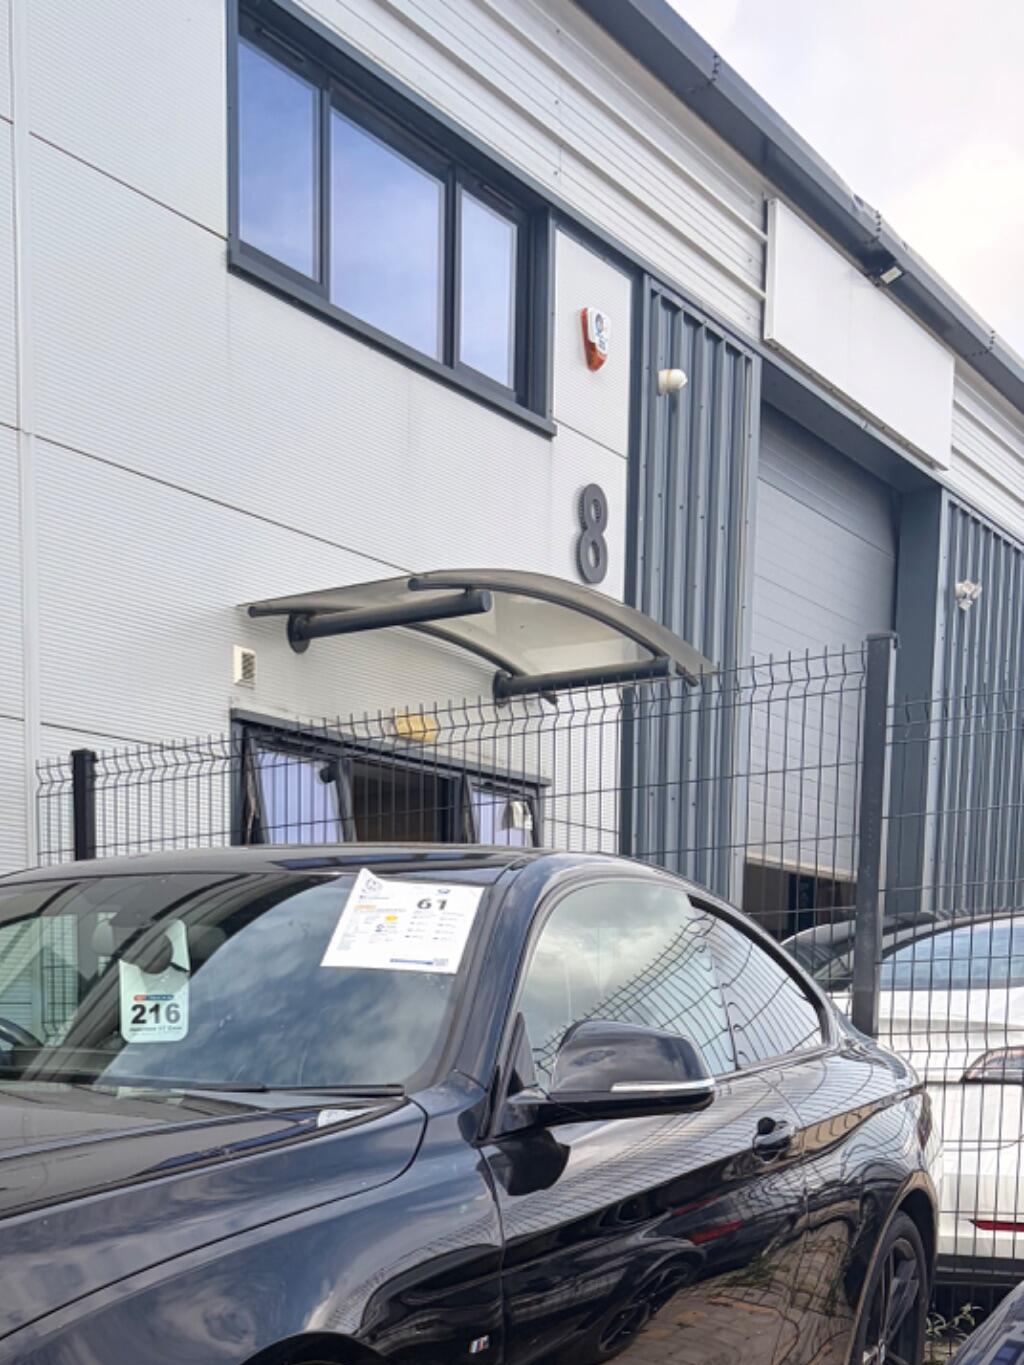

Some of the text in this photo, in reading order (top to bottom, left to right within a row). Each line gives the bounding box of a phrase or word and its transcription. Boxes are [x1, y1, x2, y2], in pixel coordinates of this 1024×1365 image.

[575, 483, 608, 584] 8
[417, 898, 447, 911] 61
[131, 1003, 181, 1025] 216
